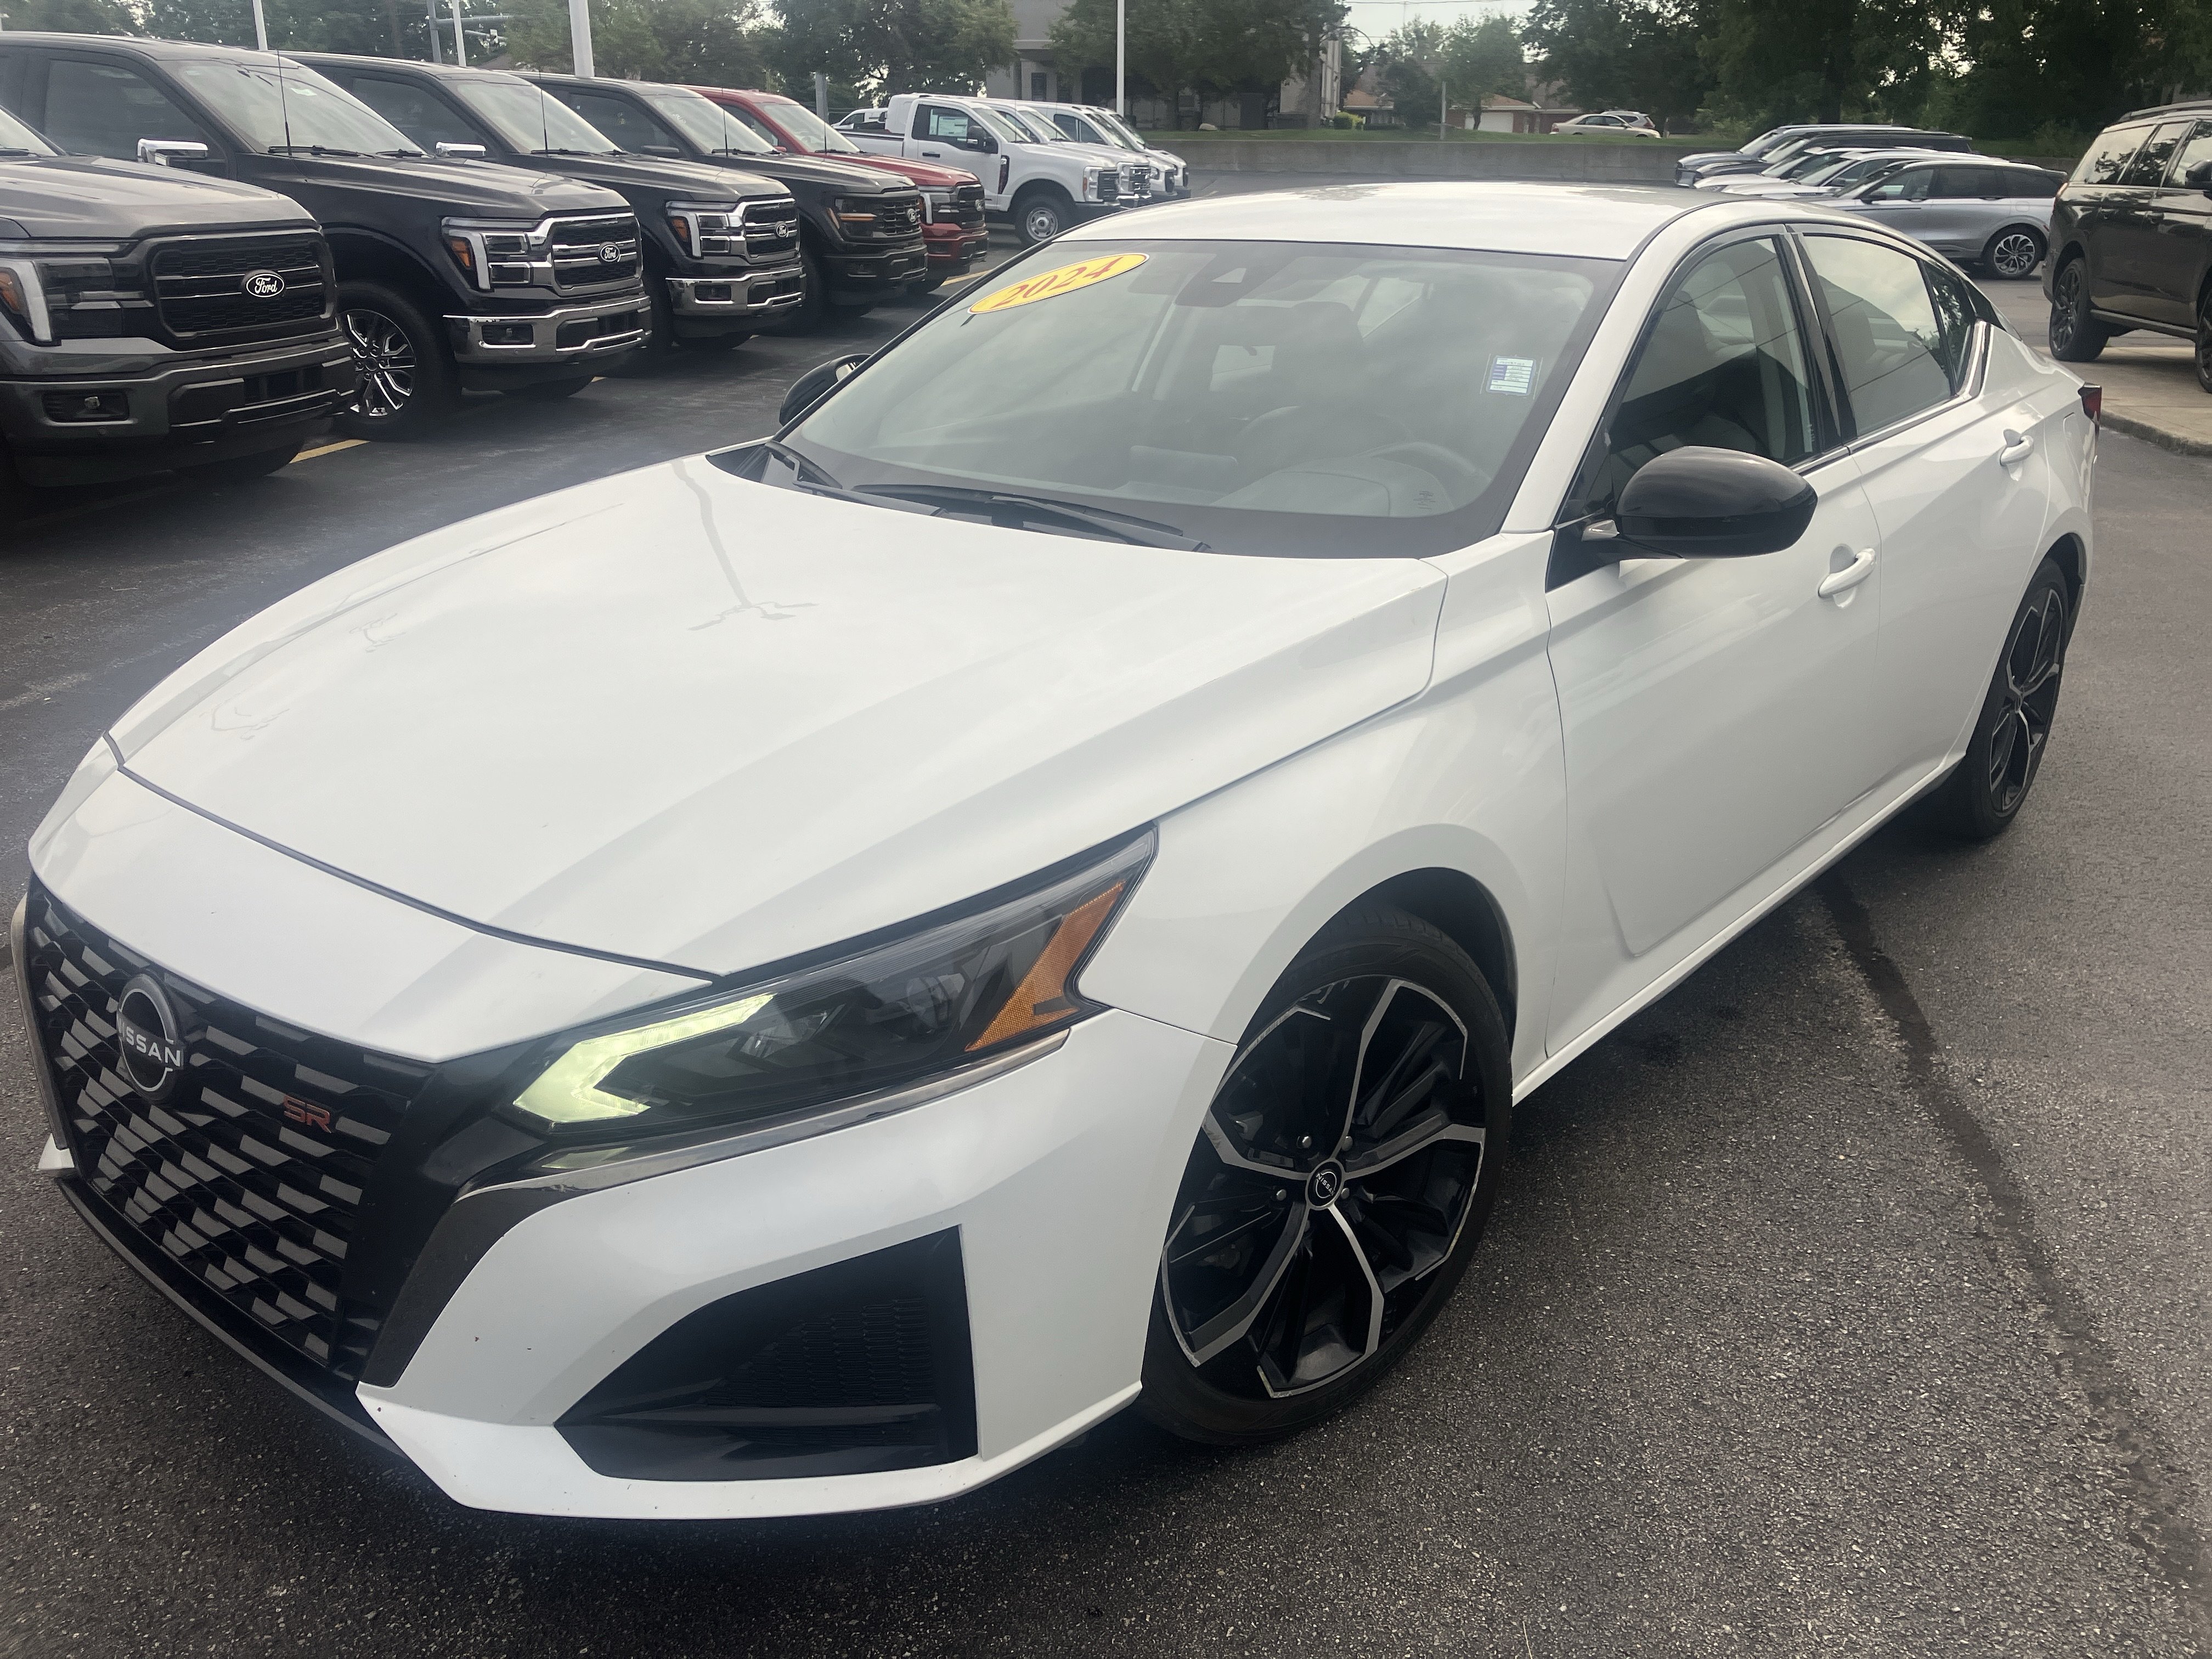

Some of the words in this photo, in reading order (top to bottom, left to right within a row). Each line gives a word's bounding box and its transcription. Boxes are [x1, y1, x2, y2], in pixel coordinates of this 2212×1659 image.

[254, 277, 278, 294] Ford
[990, 256, 1124, 309] 2024
[117, 1017, 180, 1067] NISSAN
[283, 1094, 332, 1134] SR
